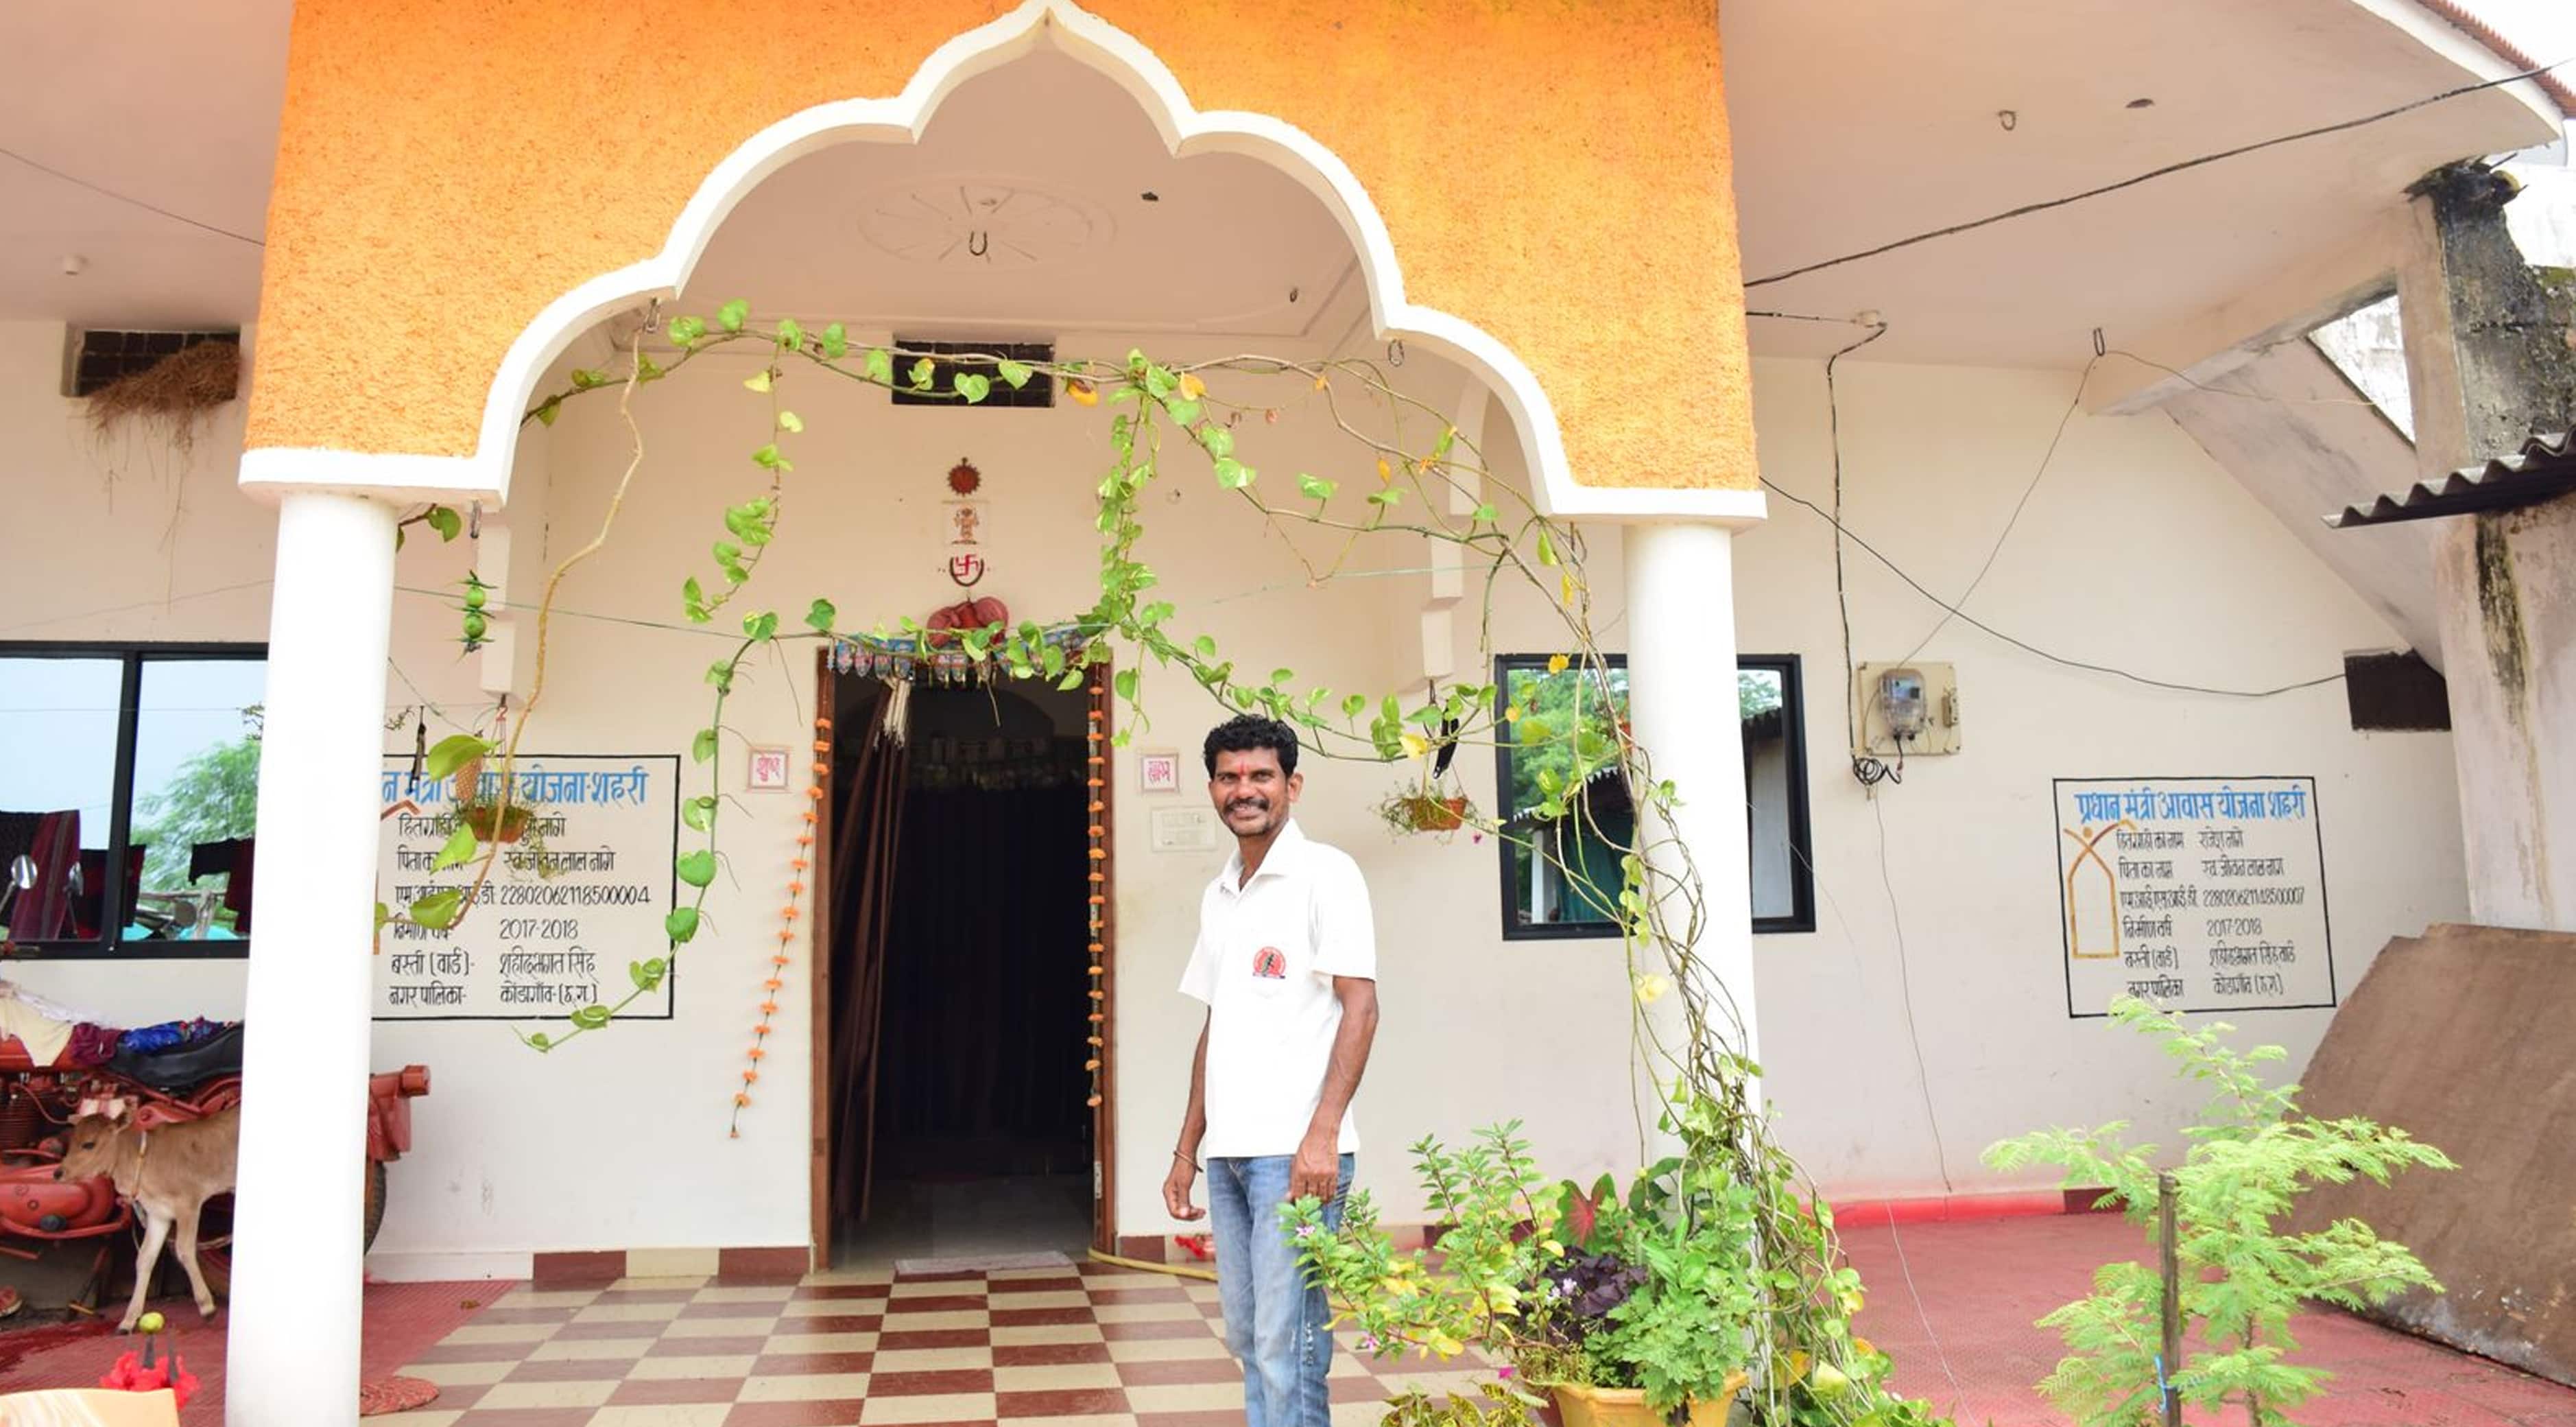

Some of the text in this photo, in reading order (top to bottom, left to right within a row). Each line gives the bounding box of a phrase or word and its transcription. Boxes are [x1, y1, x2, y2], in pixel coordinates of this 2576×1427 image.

[2074, 783, 2306, 823] प्रधान मंत्री आवास योजना शहरी
[499, 919, 578, 939] 2017-2018
[392, 950, 425, 976] बस्ती
